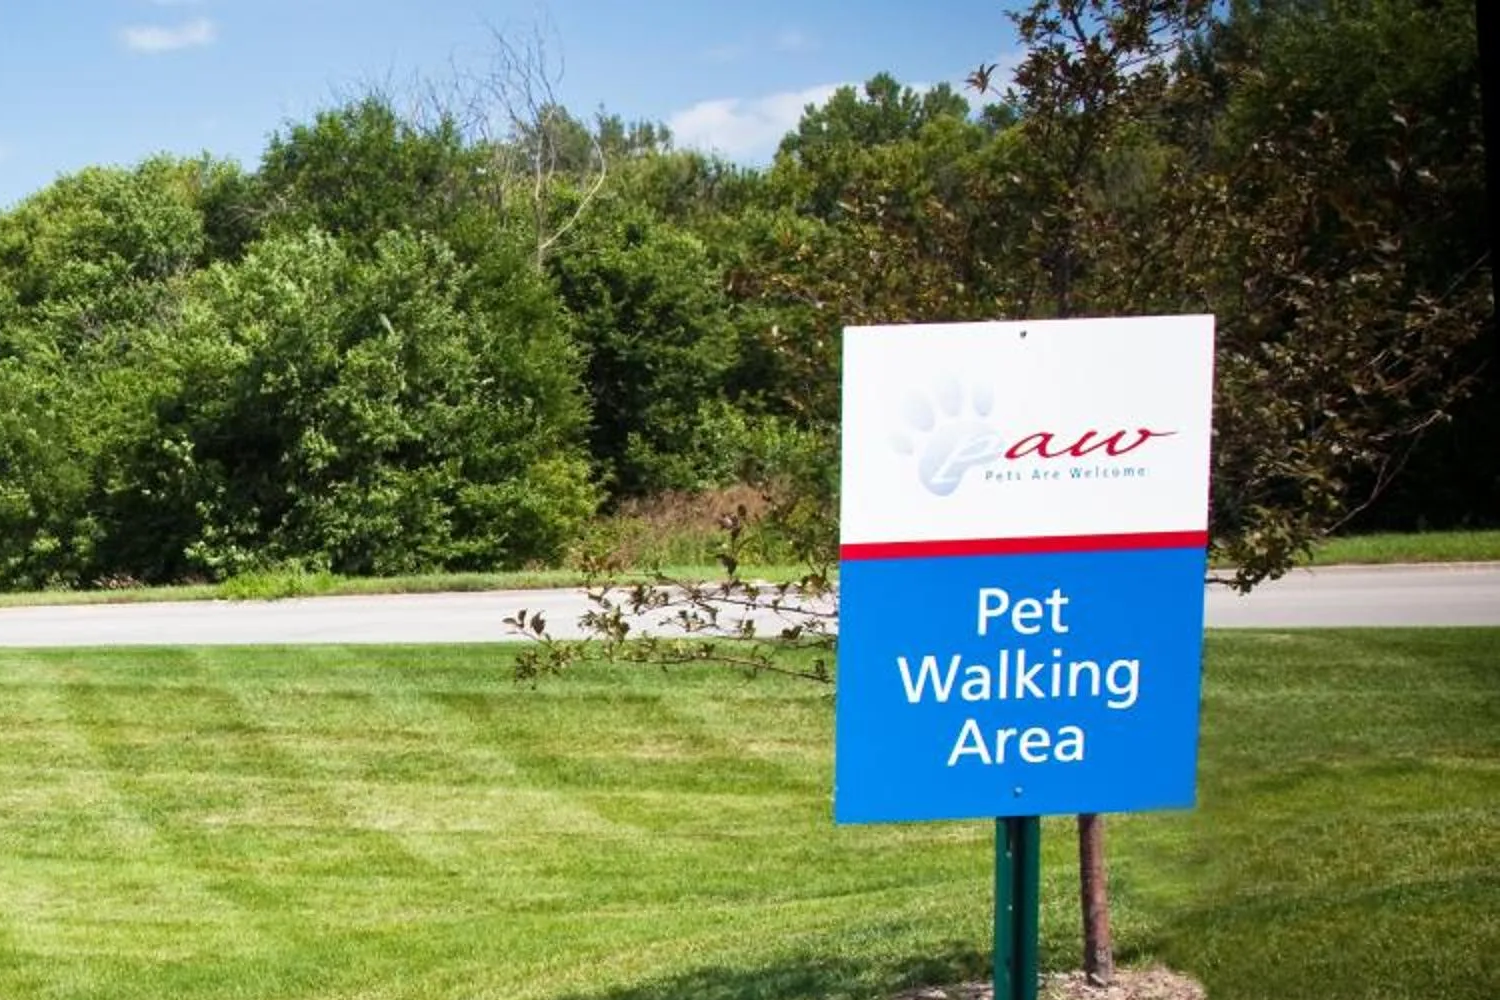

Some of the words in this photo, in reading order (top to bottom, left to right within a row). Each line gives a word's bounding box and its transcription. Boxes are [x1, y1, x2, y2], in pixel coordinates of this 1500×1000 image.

[984, 469, 1023, 482] Pets
[1031, 467, 1061, 481] Are
[1069, 465, 1147, 480] Welcome
[977, 587, 1069, 636] Pet
[897, 649, 1140, 709] Walking
[947, 719, 1085, 767] Area
